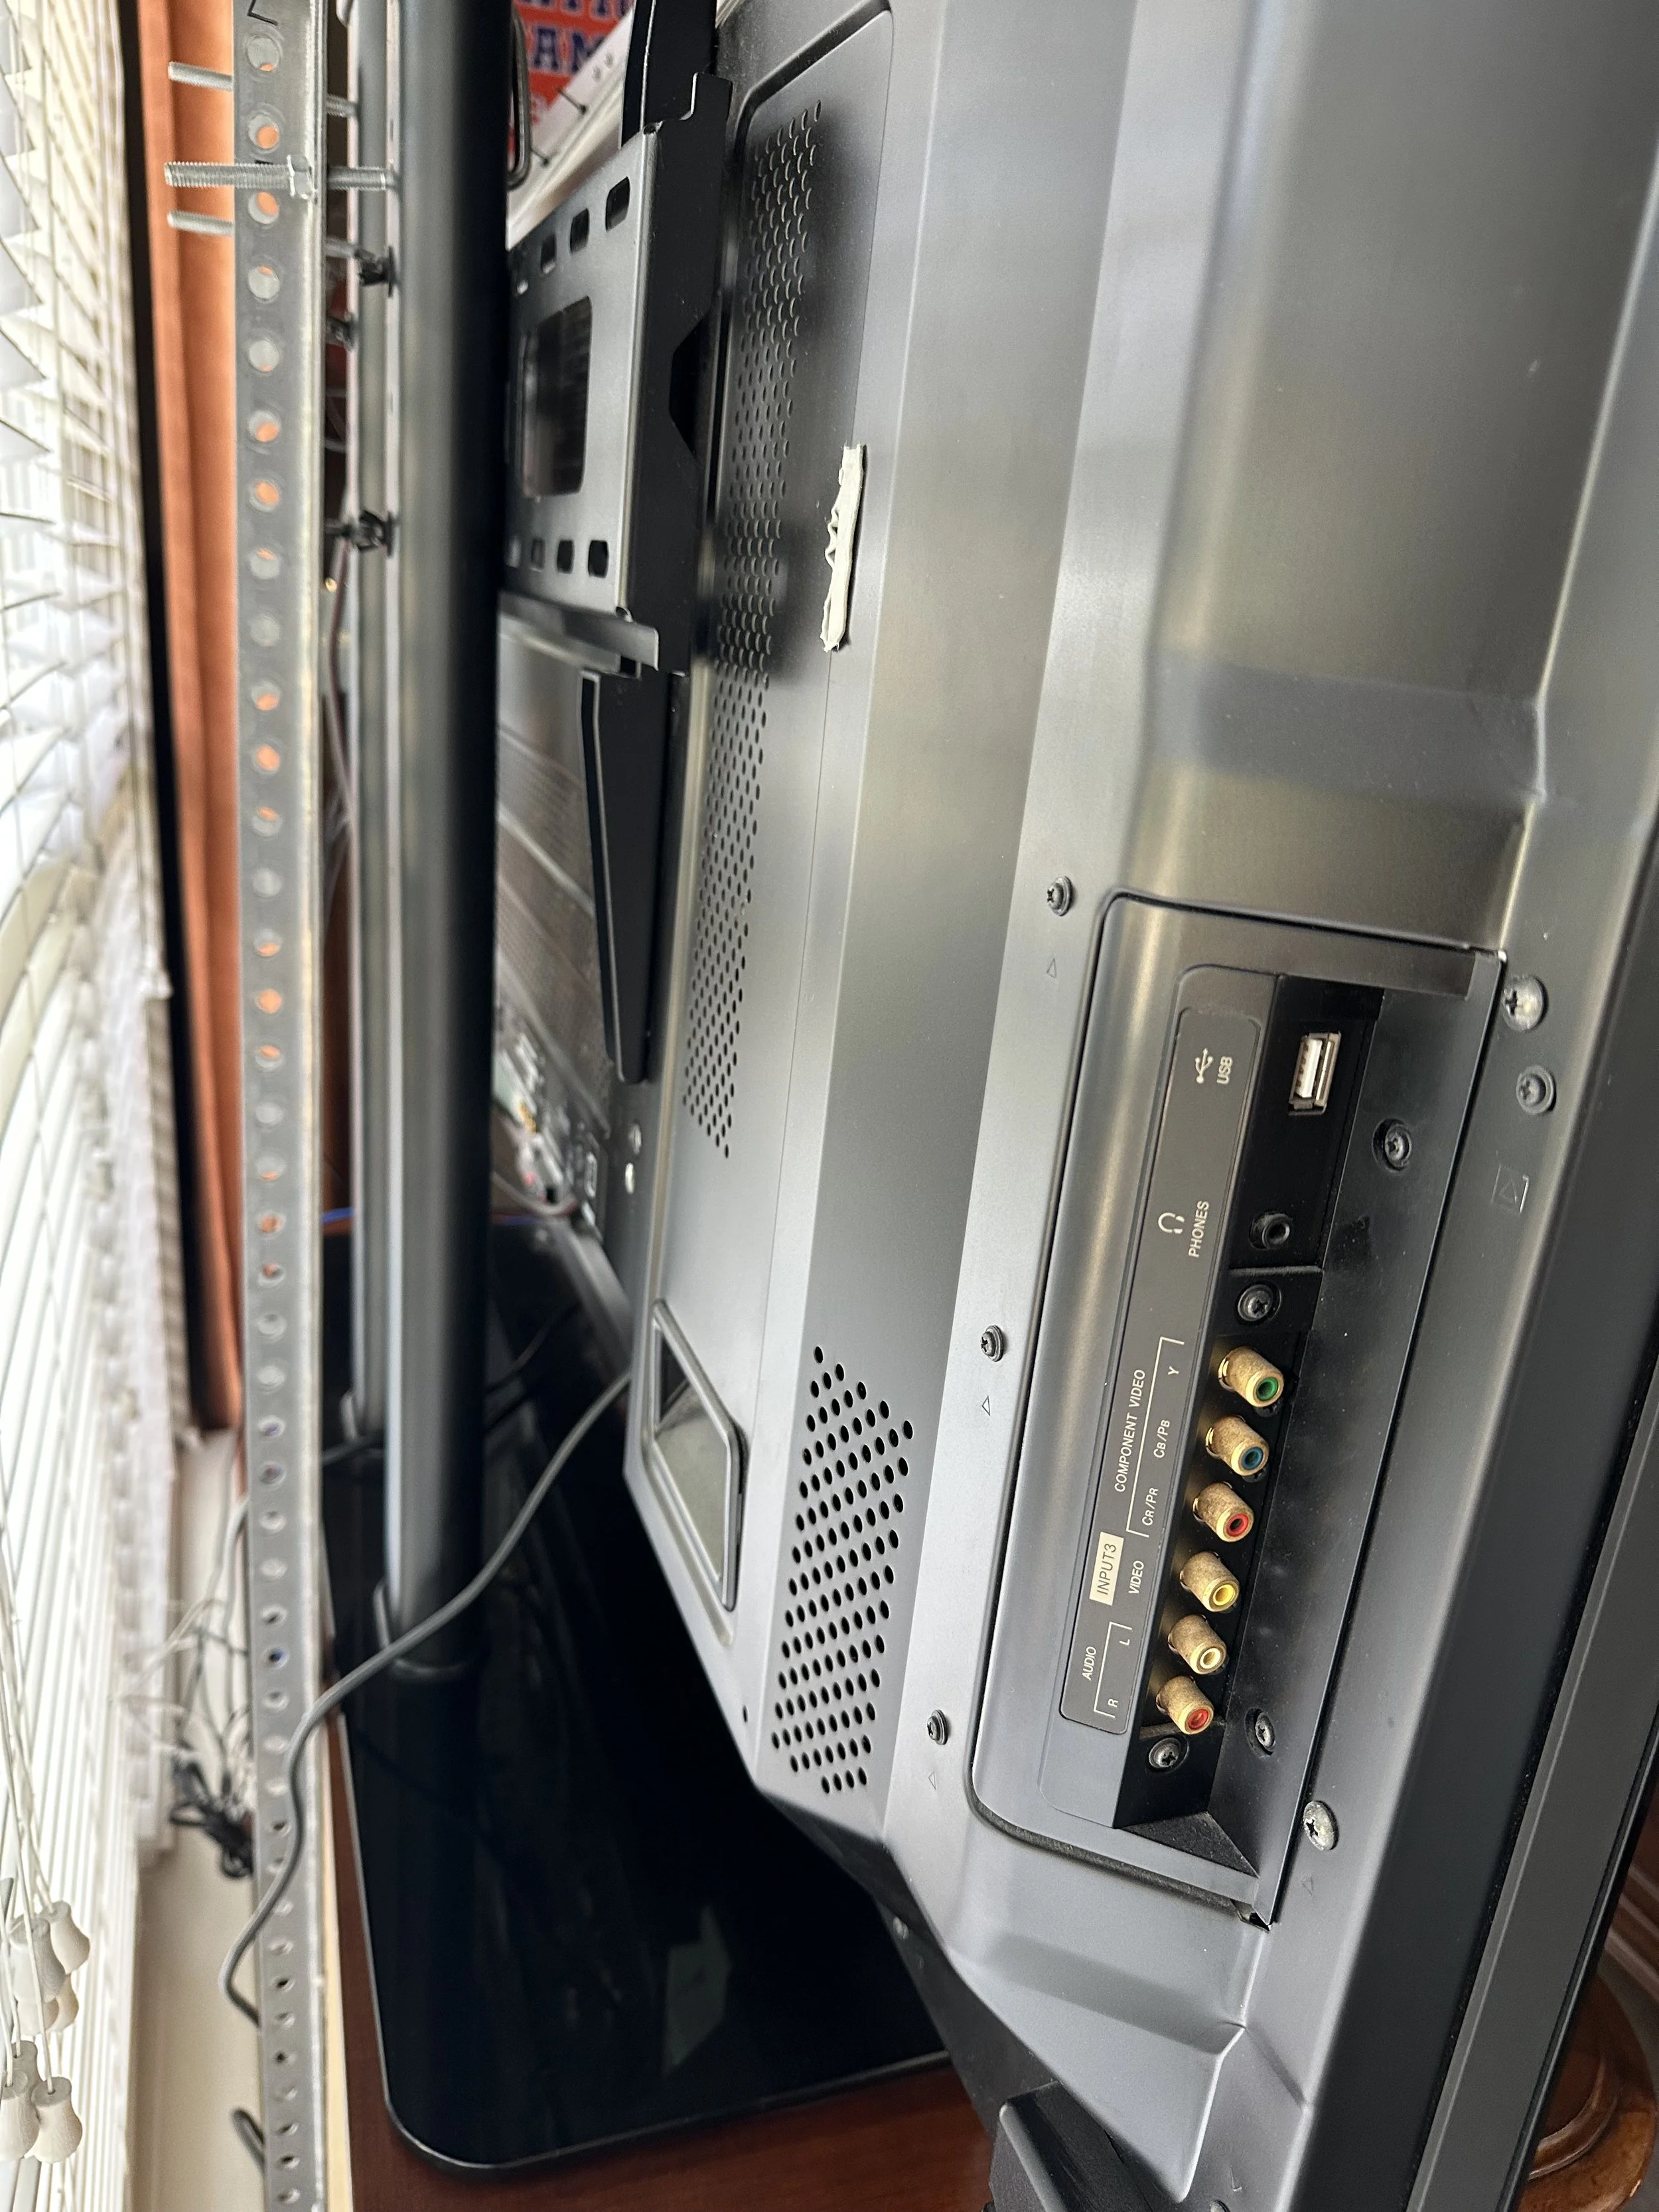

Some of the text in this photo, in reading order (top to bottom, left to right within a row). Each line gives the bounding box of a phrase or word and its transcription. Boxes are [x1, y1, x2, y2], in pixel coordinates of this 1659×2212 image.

[1216, 1056, 1233, 1084] USB
[1188, 1200, 1210, 1258] PHONES
[1167, 1366, 1179, 1375] Y
[1114, 1369, 1145, 1493] COMPONENT VIDEO
[1096, 1543, 1117, 1595] INPUT3
[1127, 1560, 1145, 1593] VIDEO
[1082, 1646, 1097, 1681] AUDIO
[1107, 1698, 1119, 1708] R
